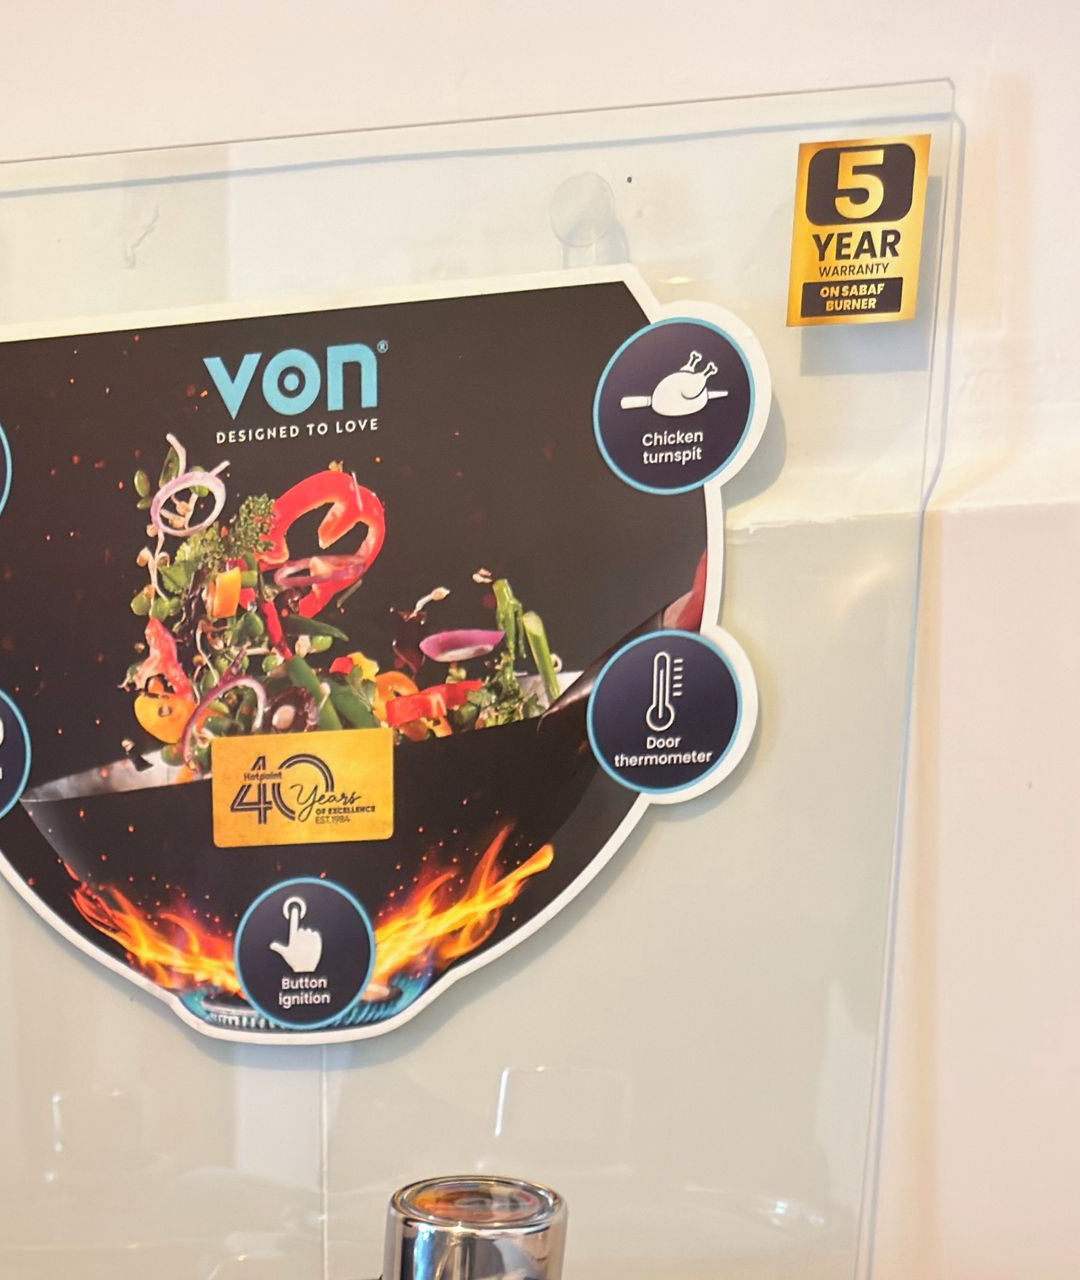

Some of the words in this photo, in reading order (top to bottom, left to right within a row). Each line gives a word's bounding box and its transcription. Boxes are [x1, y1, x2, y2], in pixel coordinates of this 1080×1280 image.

[834, 149, 885, 220] 5
[812, 229, 901, 262] YEAR
[819, 262, 890, 278] WARRANTY
[820, 285, 841, 299] ON
[841, 282, 885, 298] SABAF
[825, 297, 878, 312] BURNER
[216, 425, 300, 444] DESIGNED
[307, 422, 329, 436] TO
[336, 418, 379, 434] LOVE
[642, 430, 704, 447] Chicken
[643, 446, 703, 465] turnspit
[646, 736, 682, 749] Door
[614, 750, 713, 767] thermometer
[290, 784, 362, 822] Years
[281, 976, 328, 990] Button
[278, 991, 331, 1009] ignition
